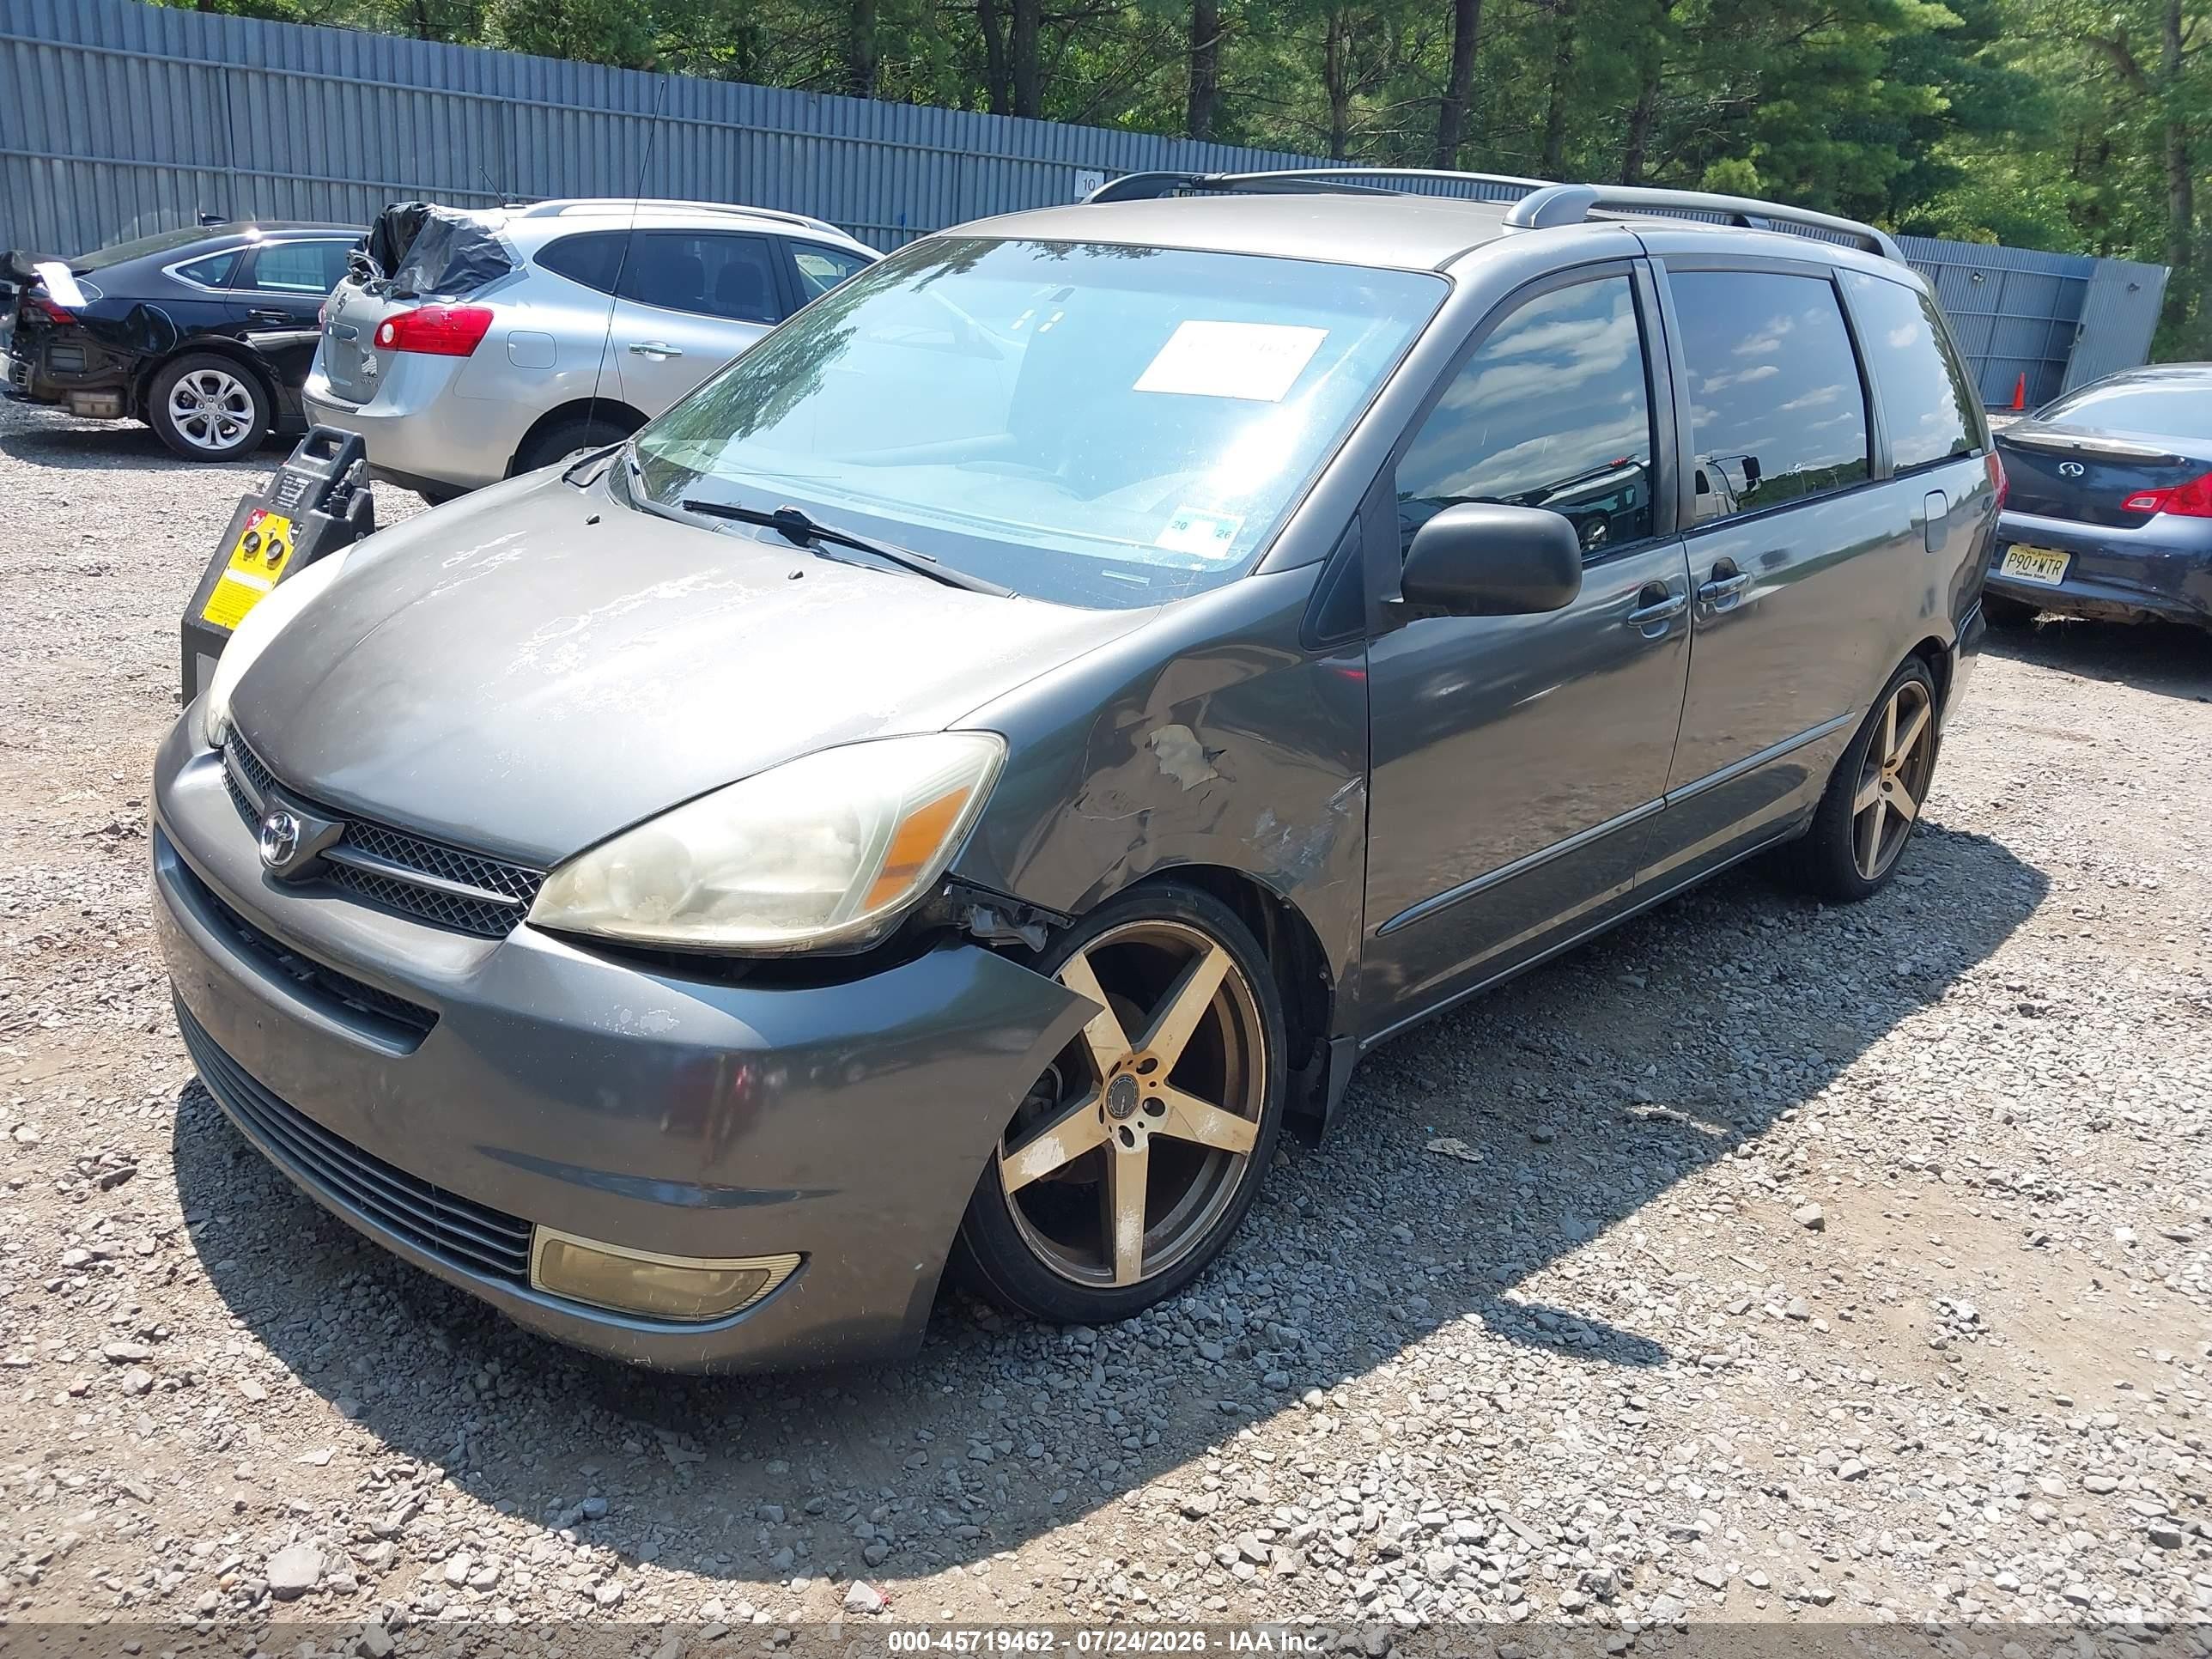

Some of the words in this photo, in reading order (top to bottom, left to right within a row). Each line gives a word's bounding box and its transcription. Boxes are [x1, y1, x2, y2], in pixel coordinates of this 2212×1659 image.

[1083, 178, 1096, 191] 10
[1171, 520, 1188, 530] 20
[1216, 529, 1231, 539] 26
